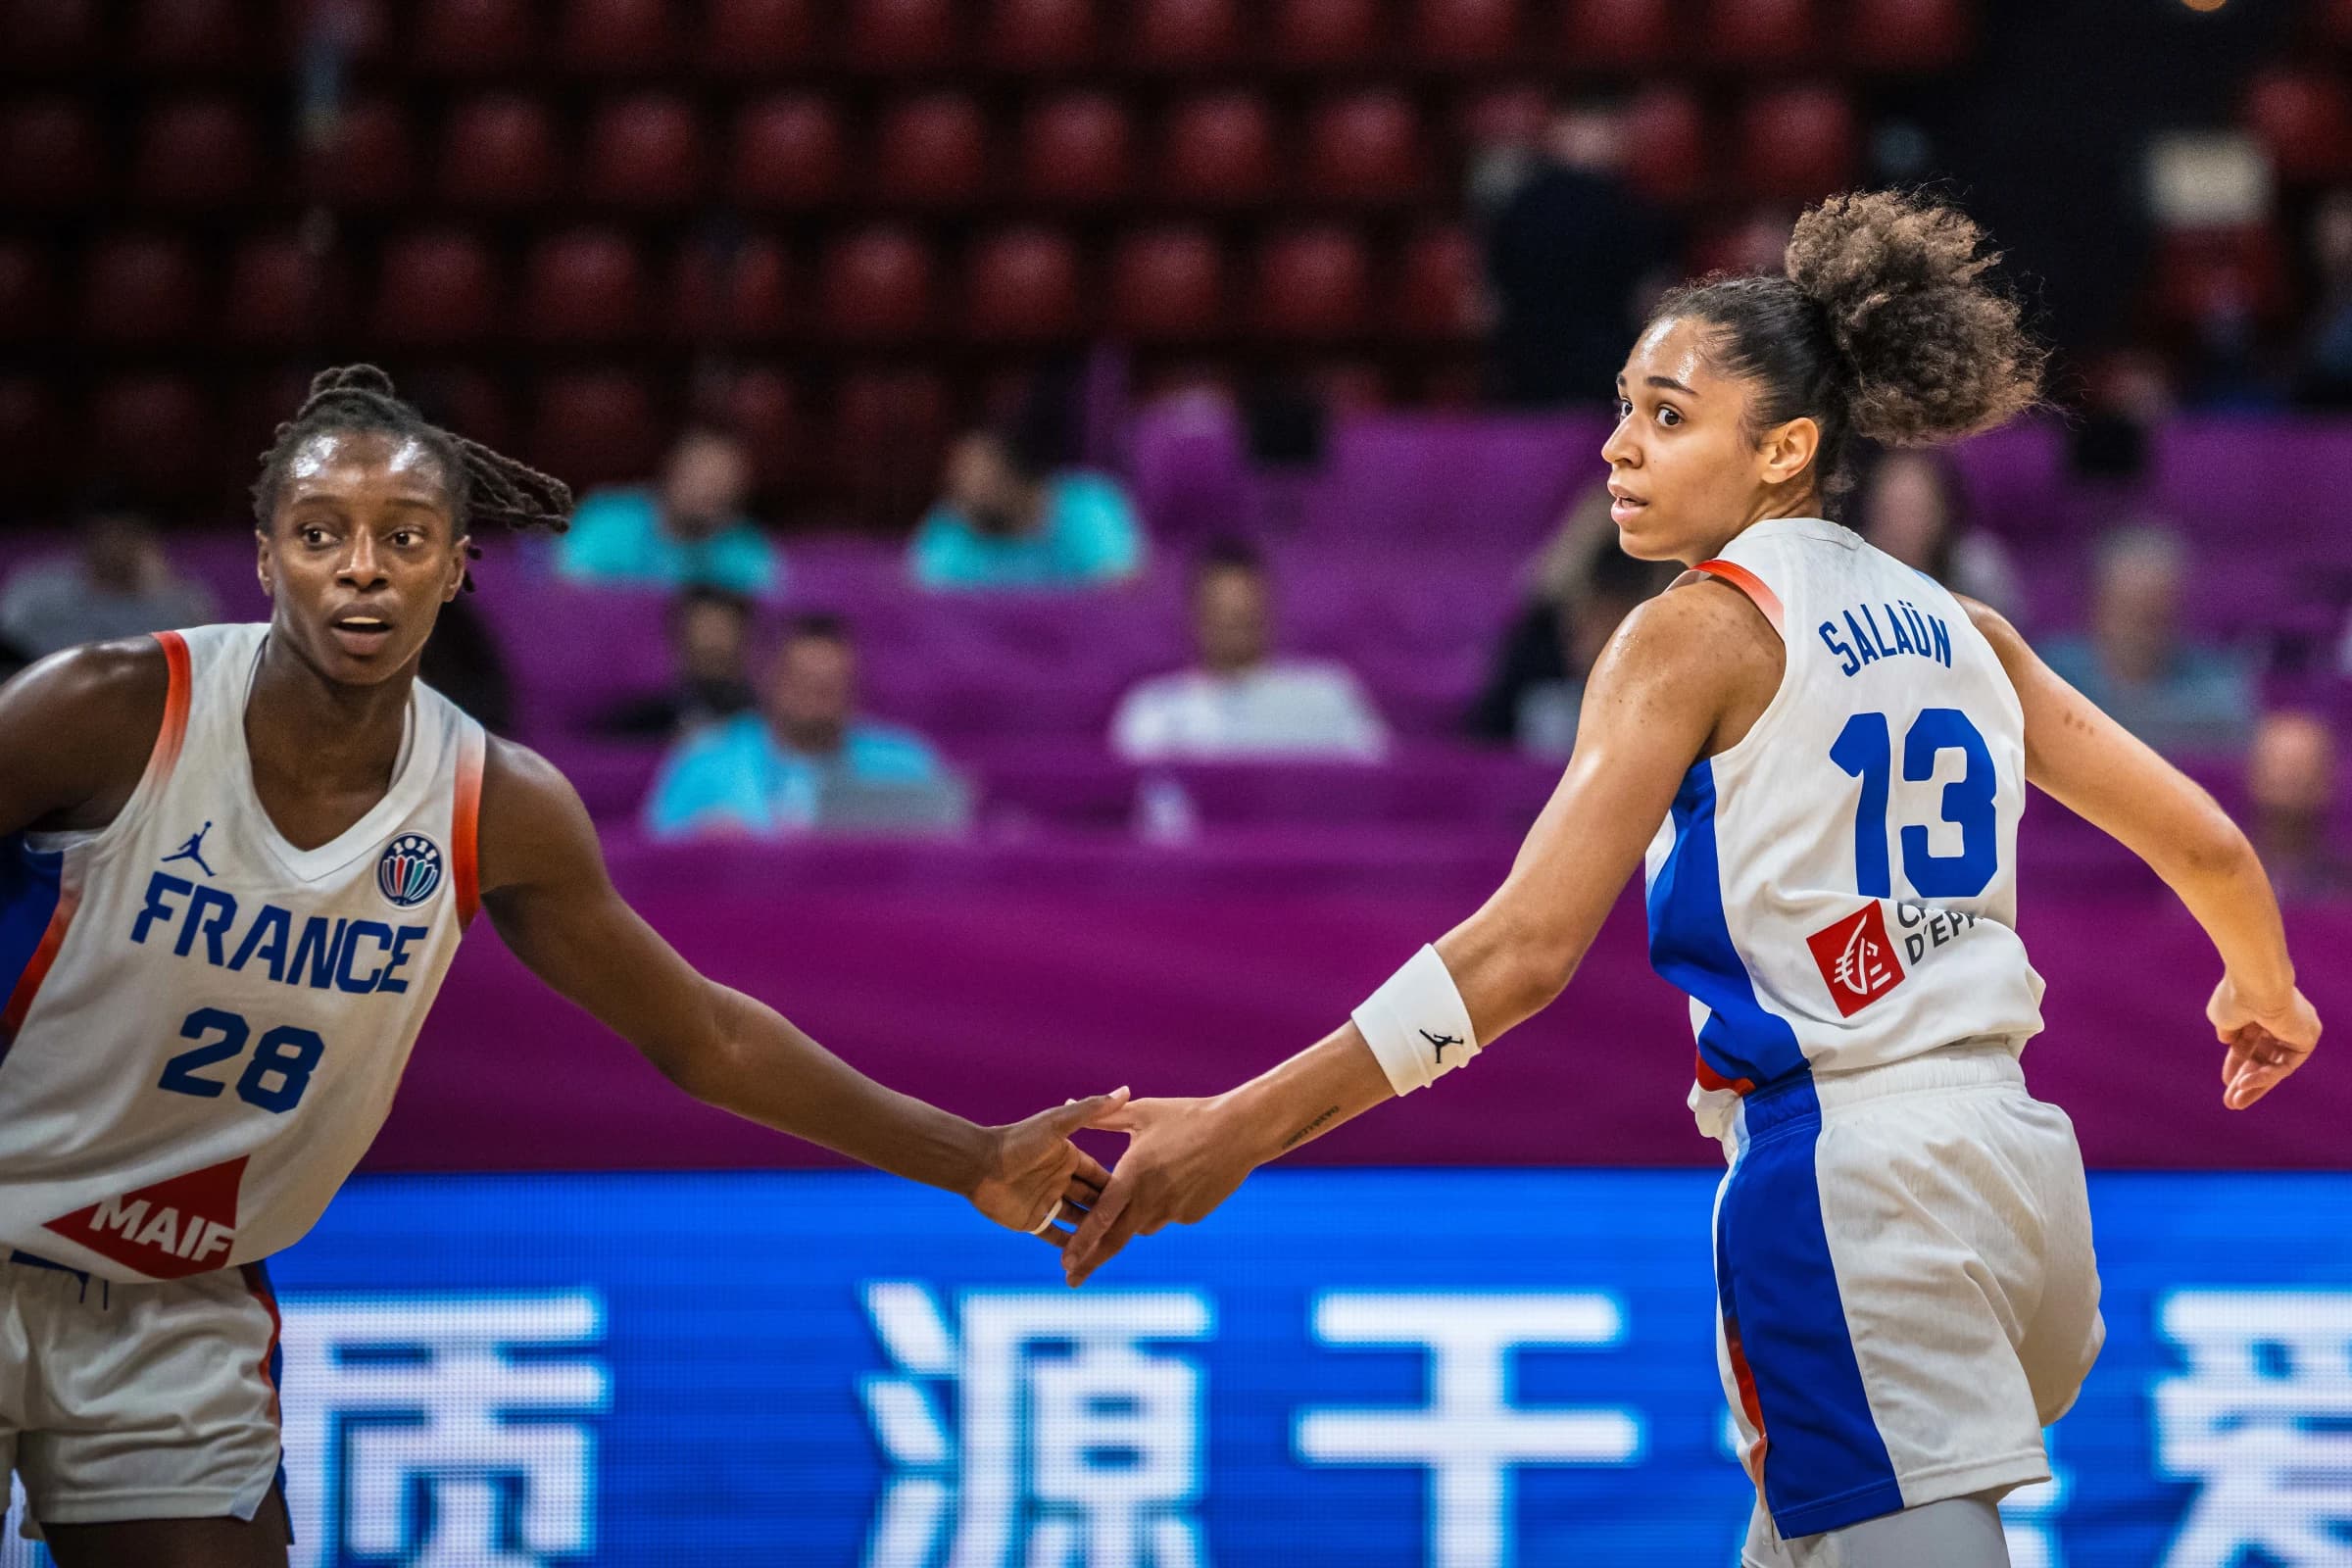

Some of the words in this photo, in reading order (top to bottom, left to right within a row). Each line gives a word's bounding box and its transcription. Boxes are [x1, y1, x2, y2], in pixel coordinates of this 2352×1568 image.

[1818, 599, 1952, 677] SALAÜN
[1829, 708, 1998, 899] 13
[130, 869, 428, 995] FRANCE
[157, 1007, 325, 1114] 28
[88, 1199, 235, 1262] MAIF
